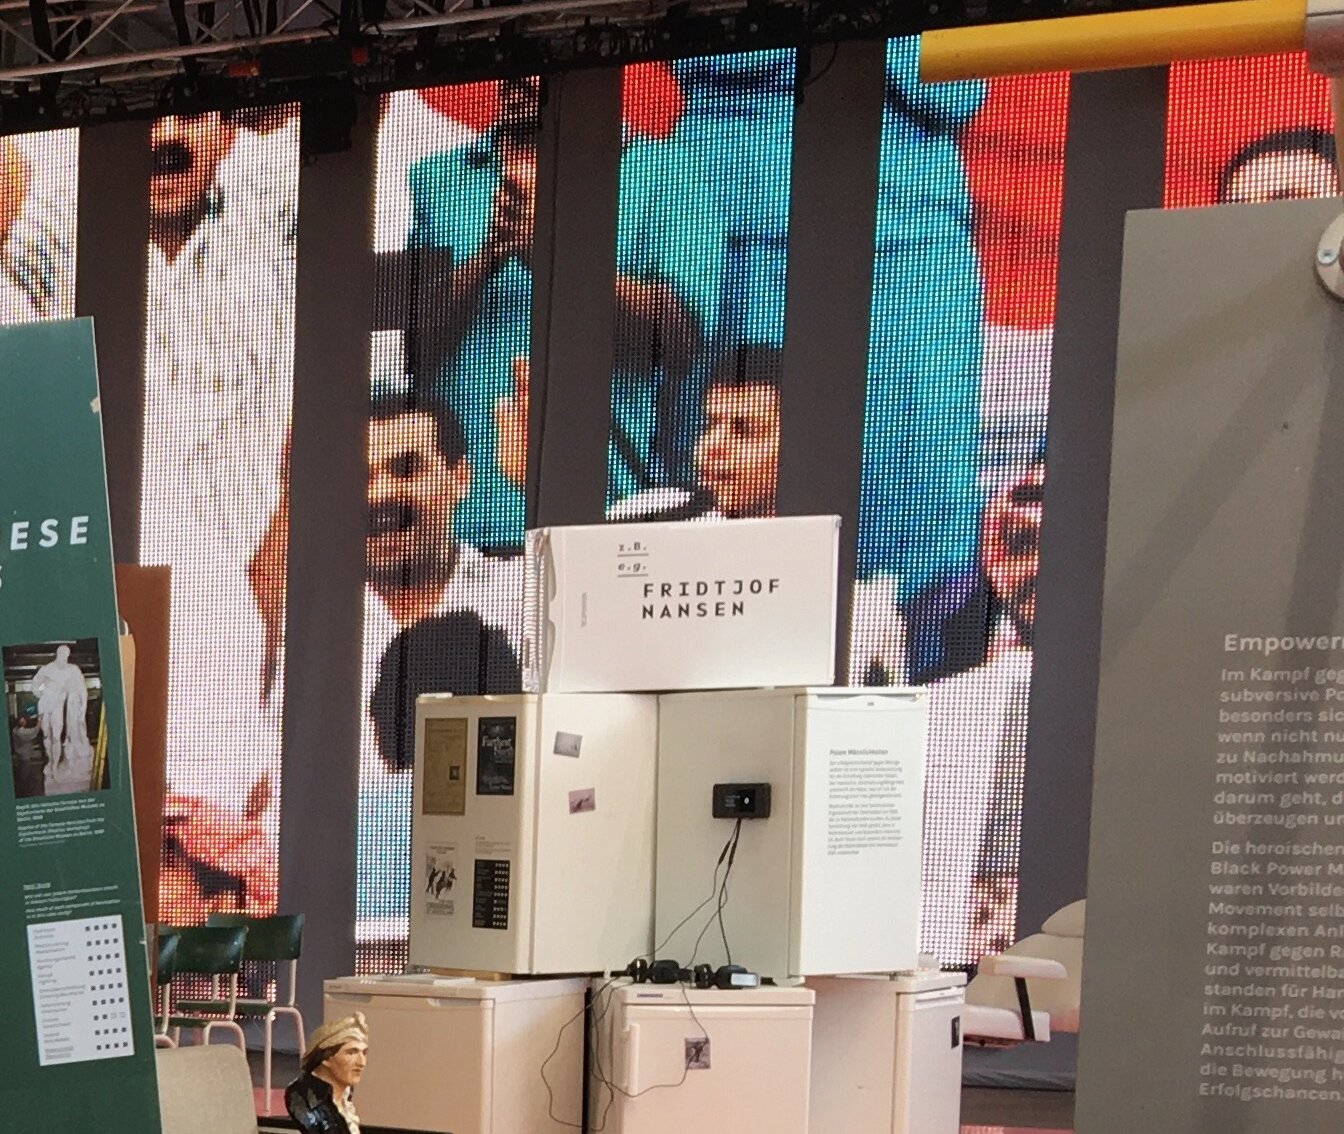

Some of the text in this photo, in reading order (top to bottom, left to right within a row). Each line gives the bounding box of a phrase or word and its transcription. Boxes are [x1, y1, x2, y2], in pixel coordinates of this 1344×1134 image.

[643, 578, 782, 599] FRIDTJOF
[642, 600, 746, 620] NANSEN
[1221, 666, 1309, 683] Im Kampf
[1219, 688, 1319, 701] subversive
[1219, 709, 1311, 722] besonders
[1218, 729, 1317, 742] wenn nicht
[1216, 753, 1237, 762] zu
[1216, 770, 1297, 783] motiviert
[1213, 791, 1274, 803] darum
[1213, 811, 1318, 828] überzeugen
[1212, 840, 1239, 853] Die
[1211, 861, 1322, 875] Black Power
[1209, 884, 1262, 894] waren
[1208, 902, 1302, 916] Movement
[1207, 922, 1308, 938] komplexen
[1206, 943, 1324, 960] Kampf gegen
[1204, 963, 1239, 975] und
[1204, 983, 1307, 996] standen für
[1203, 1002, 1225, 1014] im
[1297, 1005, 1324, 1018] die
[1201, 1022, 1288, 1037] Aufruf zur
[1200, 1062, 1326, 1083] die Bewegung
